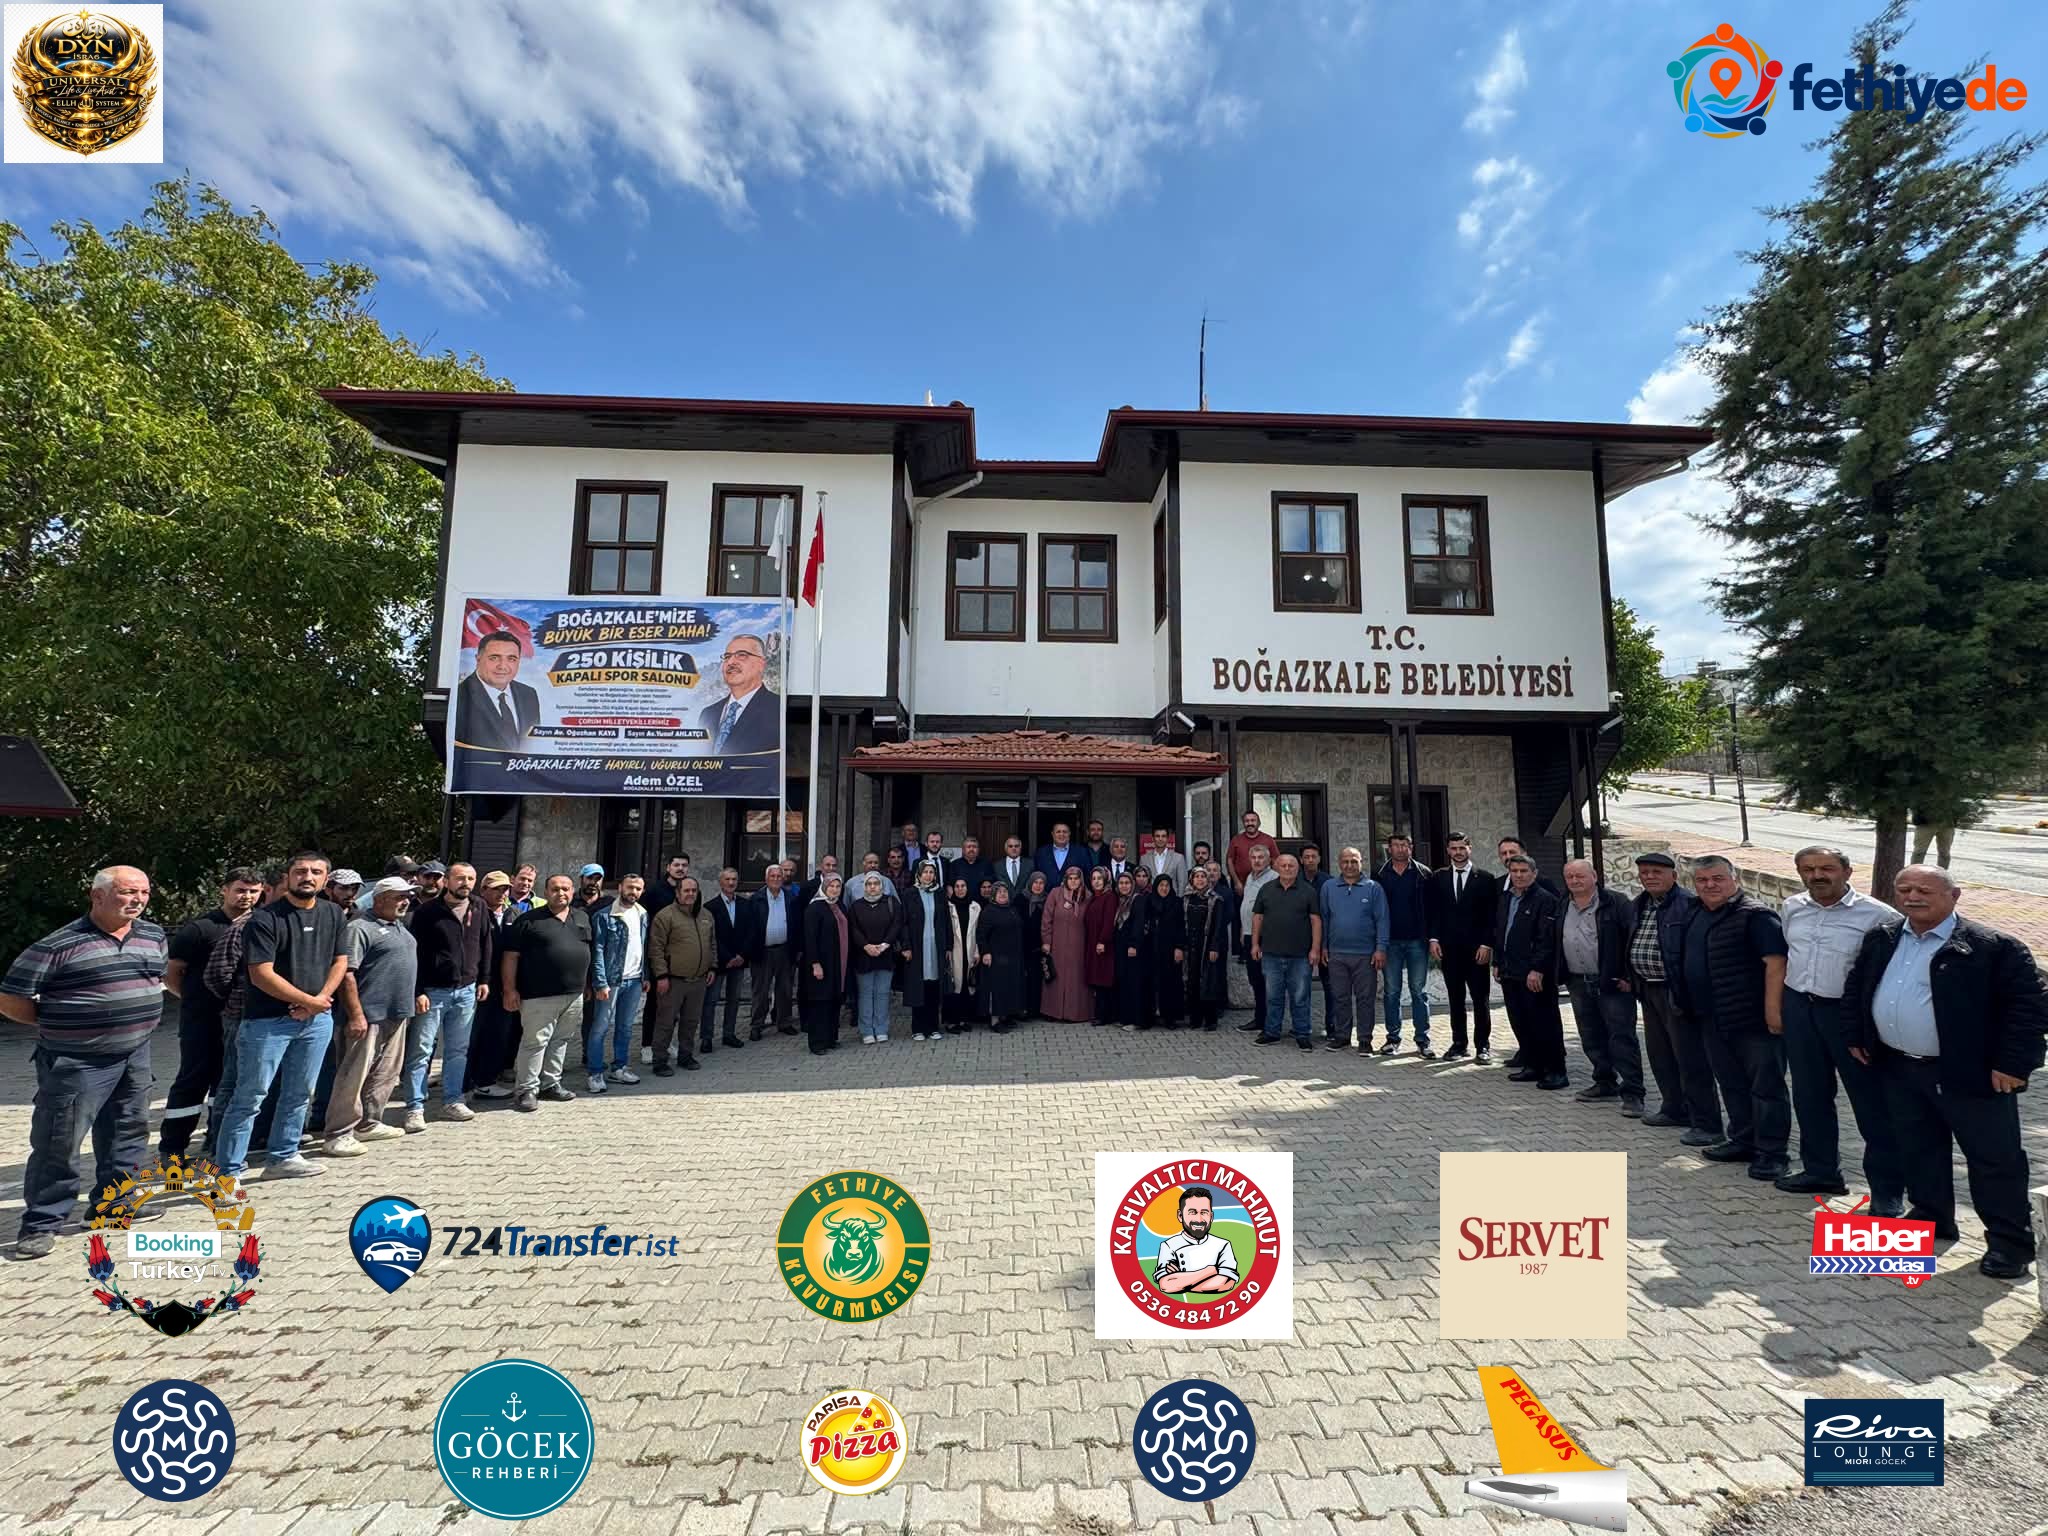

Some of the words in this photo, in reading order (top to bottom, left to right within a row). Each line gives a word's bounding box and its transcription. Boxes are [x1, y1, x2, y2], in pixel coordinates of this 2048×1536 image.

[557, 609, 696, 628] BOĞAZKALE'MİZE
[543, 627, 594, 645] BÜYÜK
[598, 627, 624, 641] BİR
[628, 625, 665, 639] ESER
[668, 623, 711, 638] DAHA!
[1366, 625, 1426, 651] T.C.
[566, 651, 608, 670] 250
[612, 649, 683, 671] KİŞİLİK
[556, 671, 602, 684] KAPALI
[605, 670, 638, 682] SPOR
[641, 672, 692, 685] SALONU
[1212, 647, 1391, 695] BOĞAZKALE
[1400, 655, 1574, 698] BELEDİYESİ
[598, 729, 616, 737] KAYA
[506, 757, 602, 771] BOĞAZKALE'MİZE
[650, 758, 689, 770] UĞURLU
[692, 759, 724, 770] OLSUN
[623, 775, 662, 786] Adem
[666, 773, 703, 787] ÖZEL
